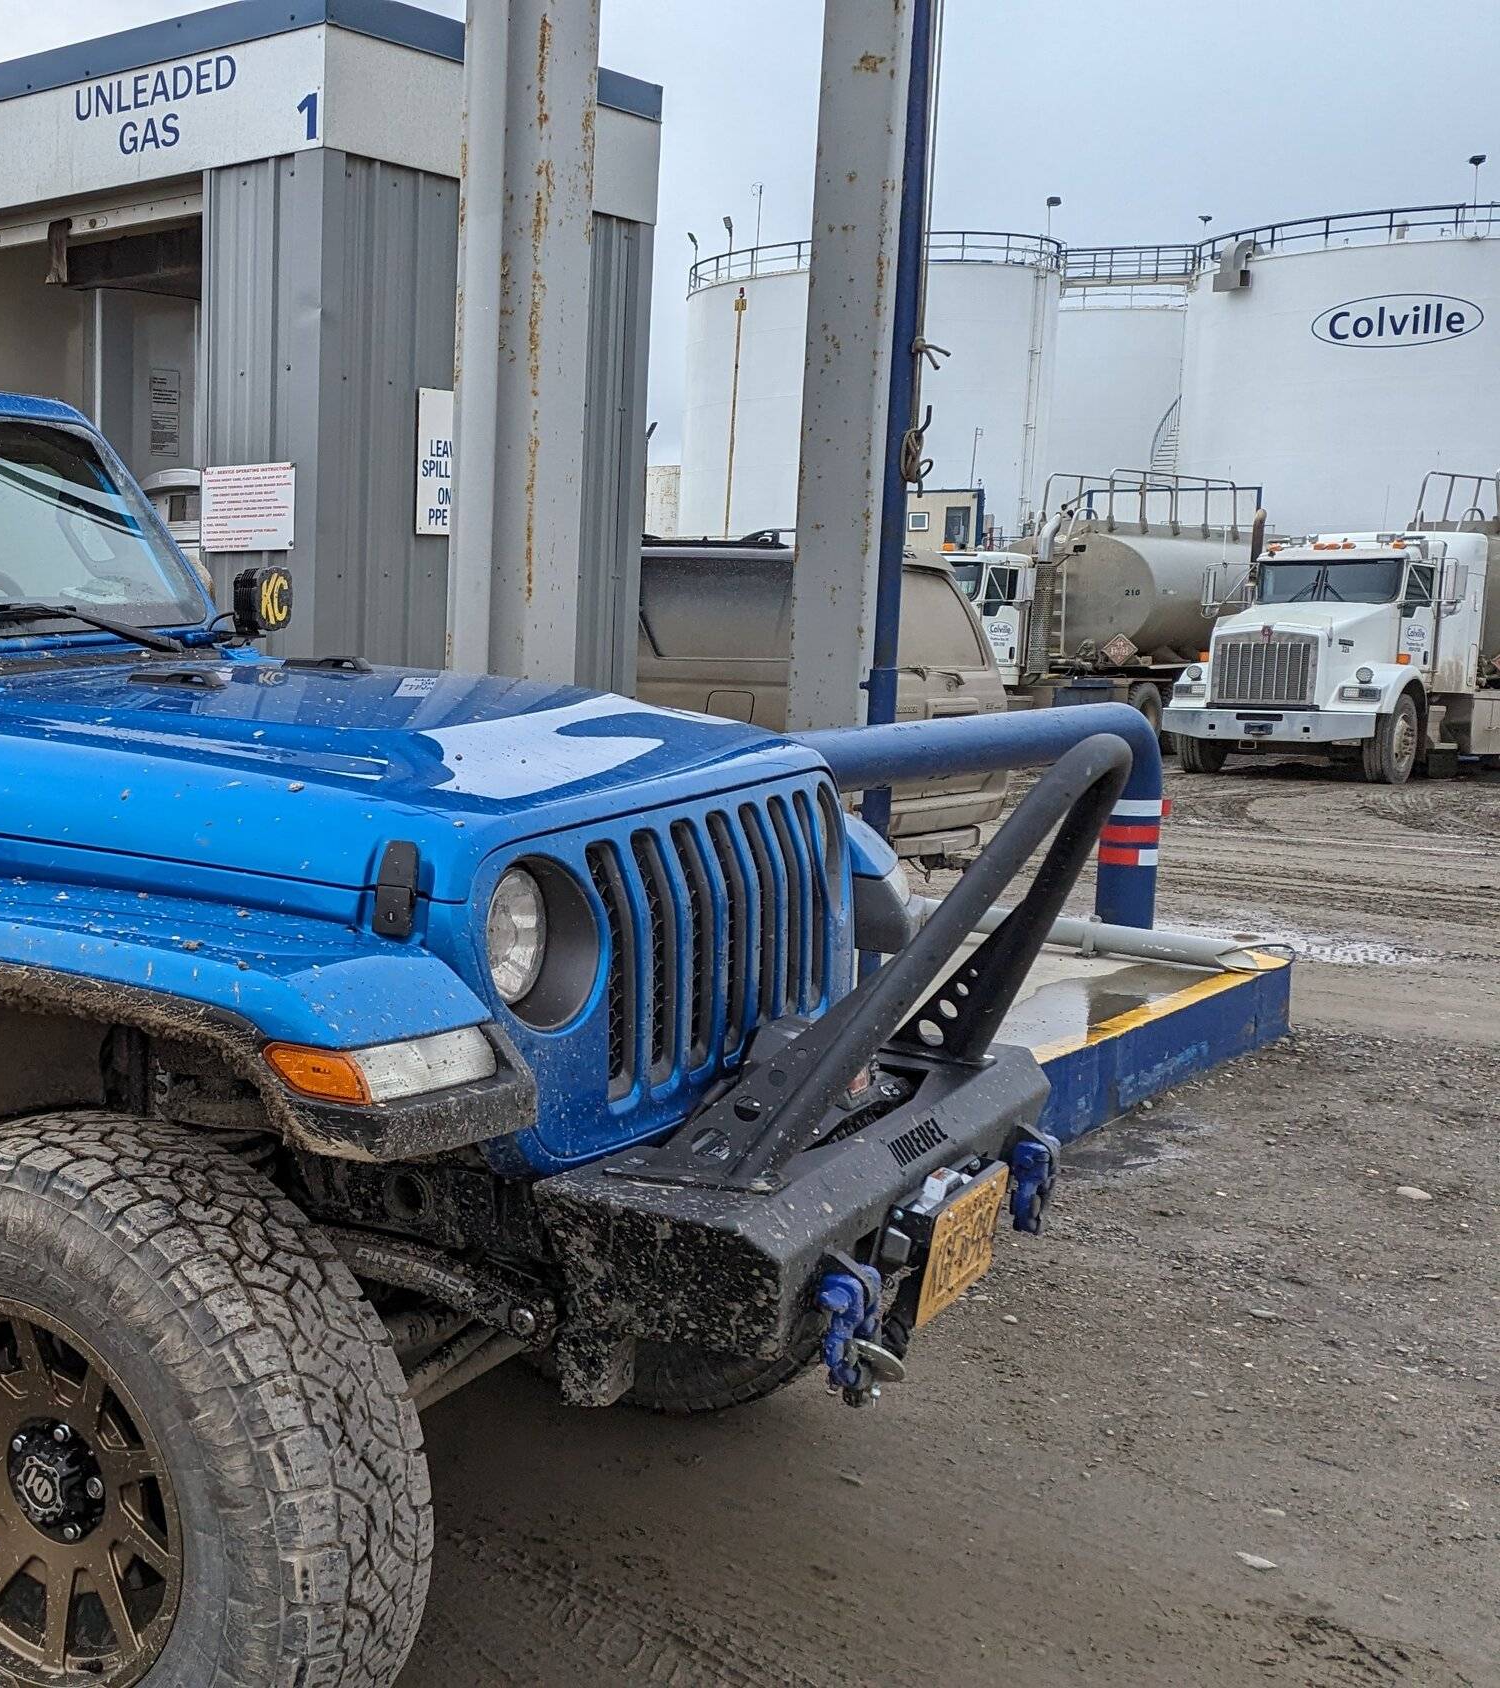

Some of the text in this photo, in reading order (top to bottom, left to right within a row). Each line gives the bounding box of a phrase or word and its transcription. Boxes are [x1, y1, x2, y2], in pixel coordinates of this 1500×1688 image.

[75, 54, 237, 121] UNLEADED
[119, 113, 180, 155] GAS
[296, 92, 318, 141] 1
[1329, 303, 1465, 340] Colville
[430, 439, 452, 457] LEA
[428, 508, 448, 526] PPE
[261, 572, 289, 625] KC
